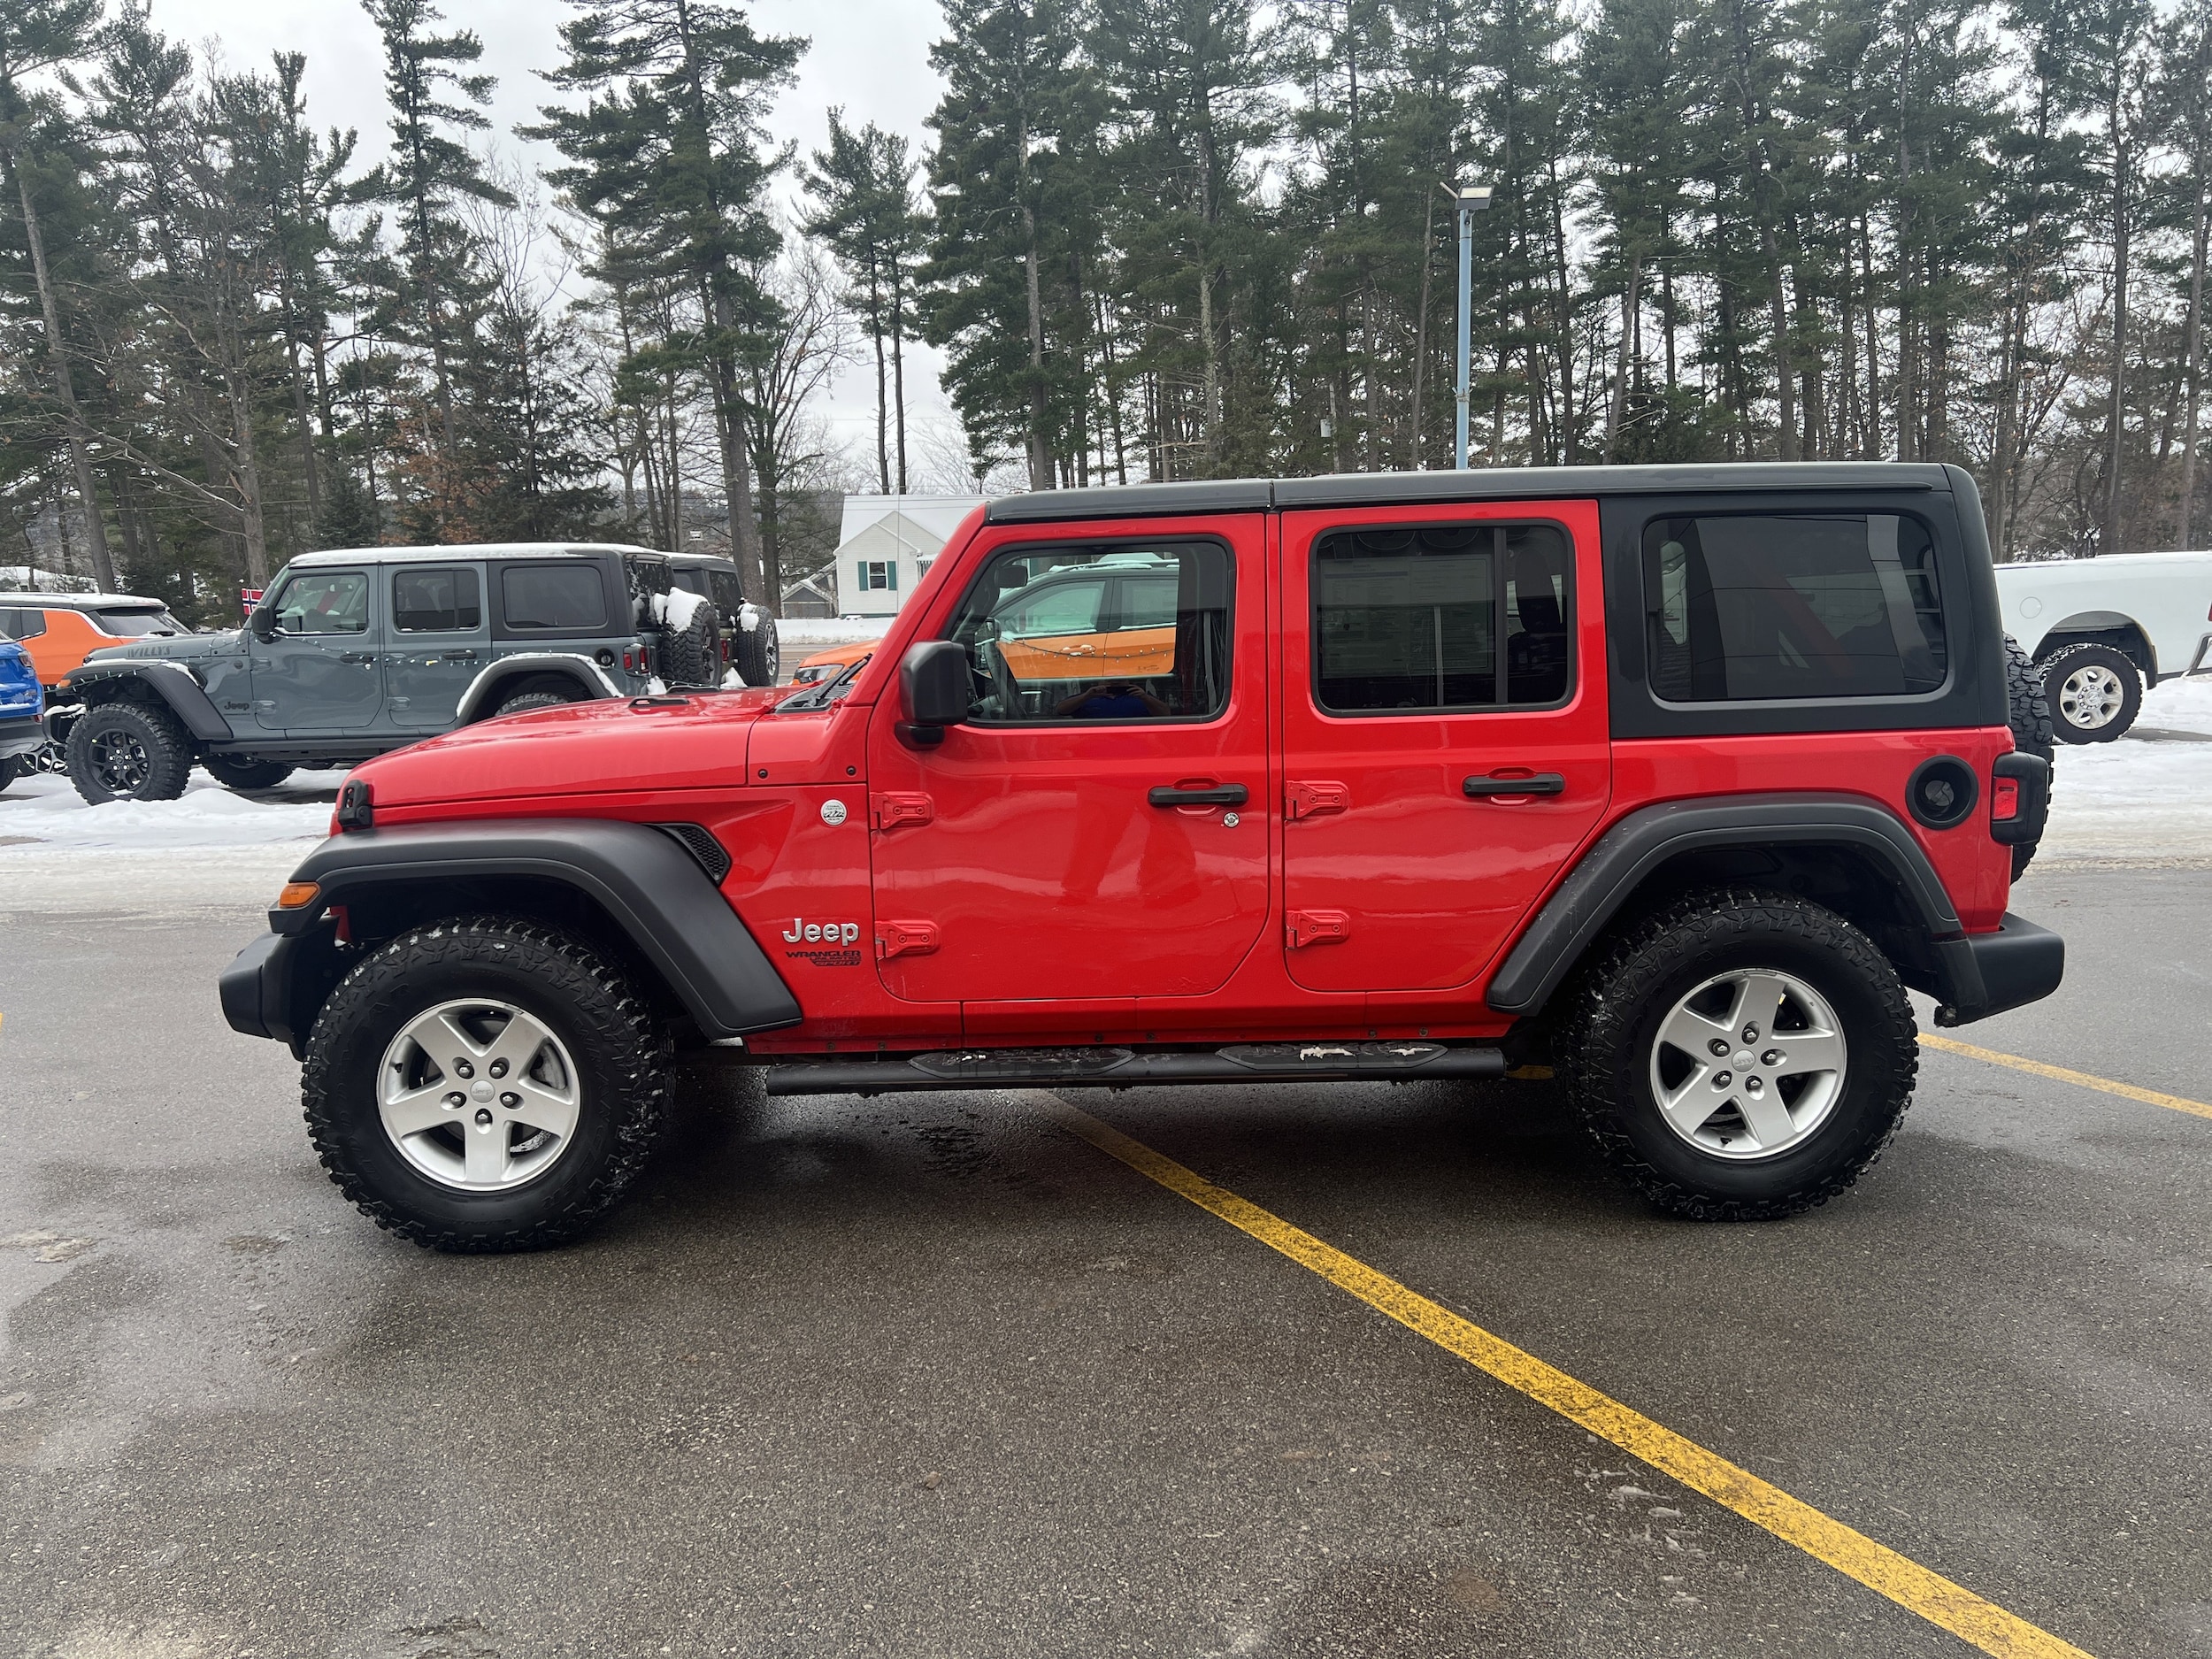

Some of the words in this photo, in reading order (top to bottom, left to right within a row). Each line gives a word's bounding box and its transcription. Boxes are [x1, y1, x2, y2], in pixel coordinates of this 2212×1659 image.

[127, 645, 173, 658] WILLYS
[224, 701, 250, 711] Jeep
[782, 918, 859, 947] Jeep
[786, 949, 861, 958] WRANGLER
